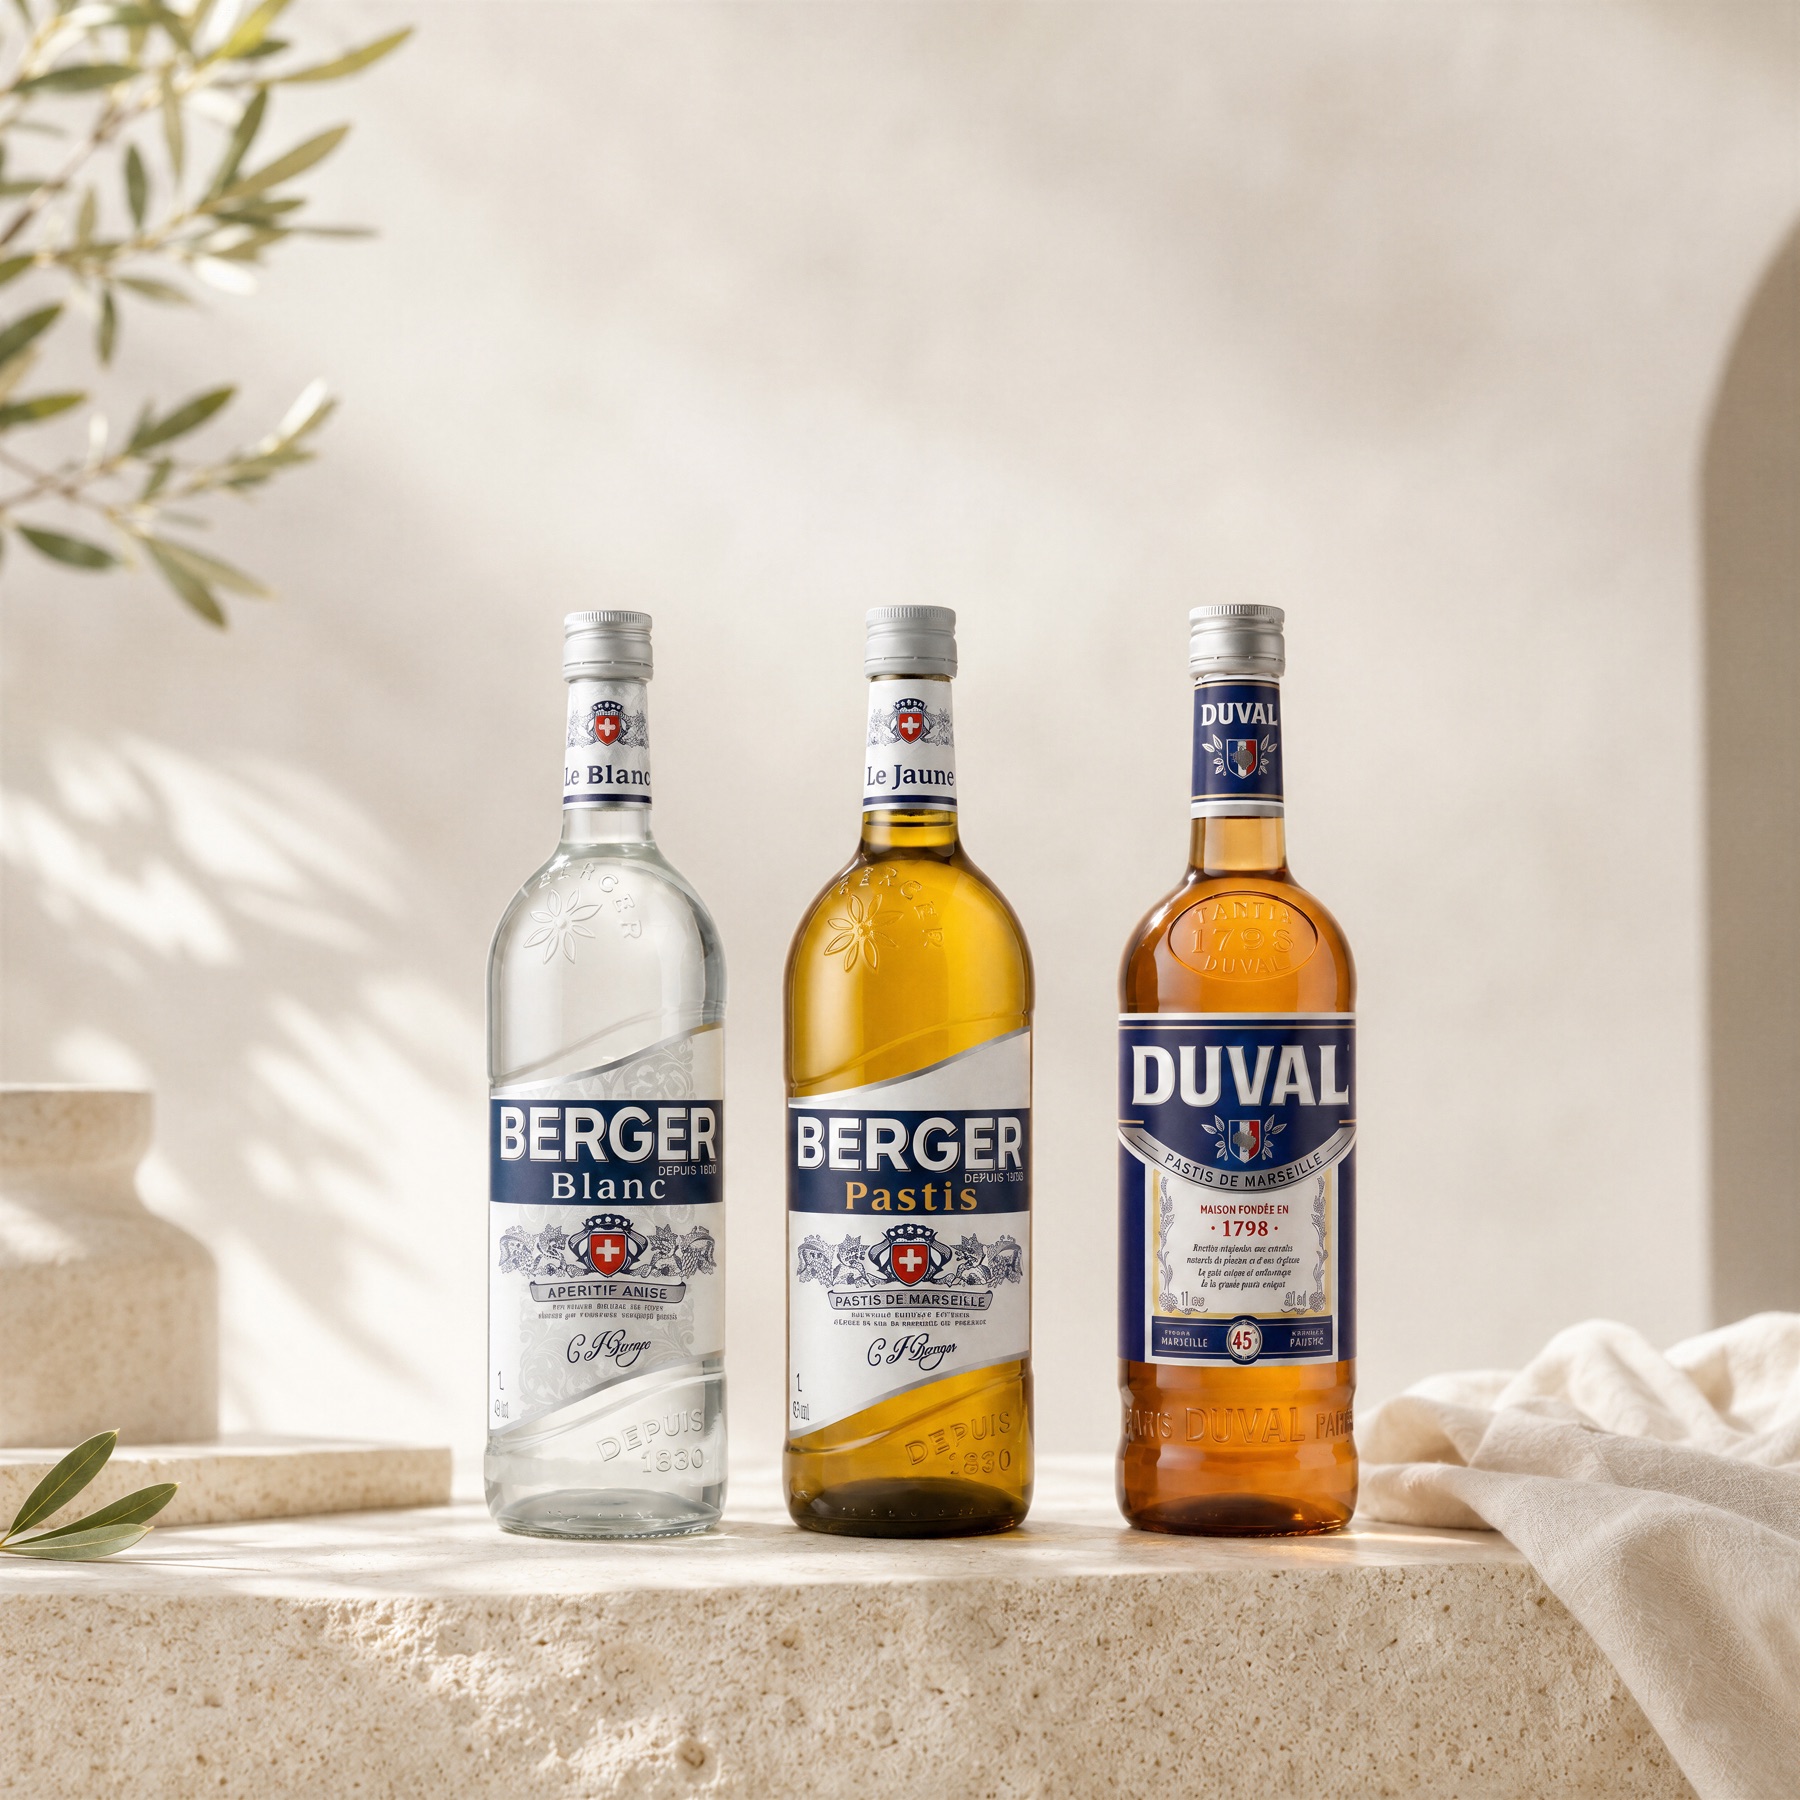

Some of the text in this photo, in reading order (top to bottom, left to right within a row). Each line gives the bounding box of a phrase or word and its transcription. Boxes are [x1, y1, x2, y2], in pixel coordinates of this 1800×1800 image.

[1201, 702, 1278, 726] DUVAL
[565, 765, 651, 786] Le Blanc
[867, 764, 955, 790] Le Jaune
[1204, 955, 1291, 974] DUVAL
[1131, 1045, 1350, 1107] DUVAL
[500, 1106, 717, 1163] BERGER
[798, 1116, 1023, 1173] BERGER
[658, 1165, 697, 1176] DEPUIS
[1164, 1152, 1323, 1188] PASTIS DE MARSEILLE
[552, 1172, 666, 1199] Blanc
[845, 1181, 978, 1211] Pastis
[1200, 1202, 1289, 1215] MAISON FONDÉE EN
[1222, 1220, 1269, 1237] 1798
[548, 1285, 668, 1299] APERITIF ANISE
[835, 1294, 986, 1307] PASTIS DE MARSEILLE
[597, 1408, 704, 1462] DEPUIS
[1185, 1407, 1305, 1443] DUVAL
[904, 1412, 1011, 1465] DEPUIS
[641, 1448, 704, 1473] 1830
